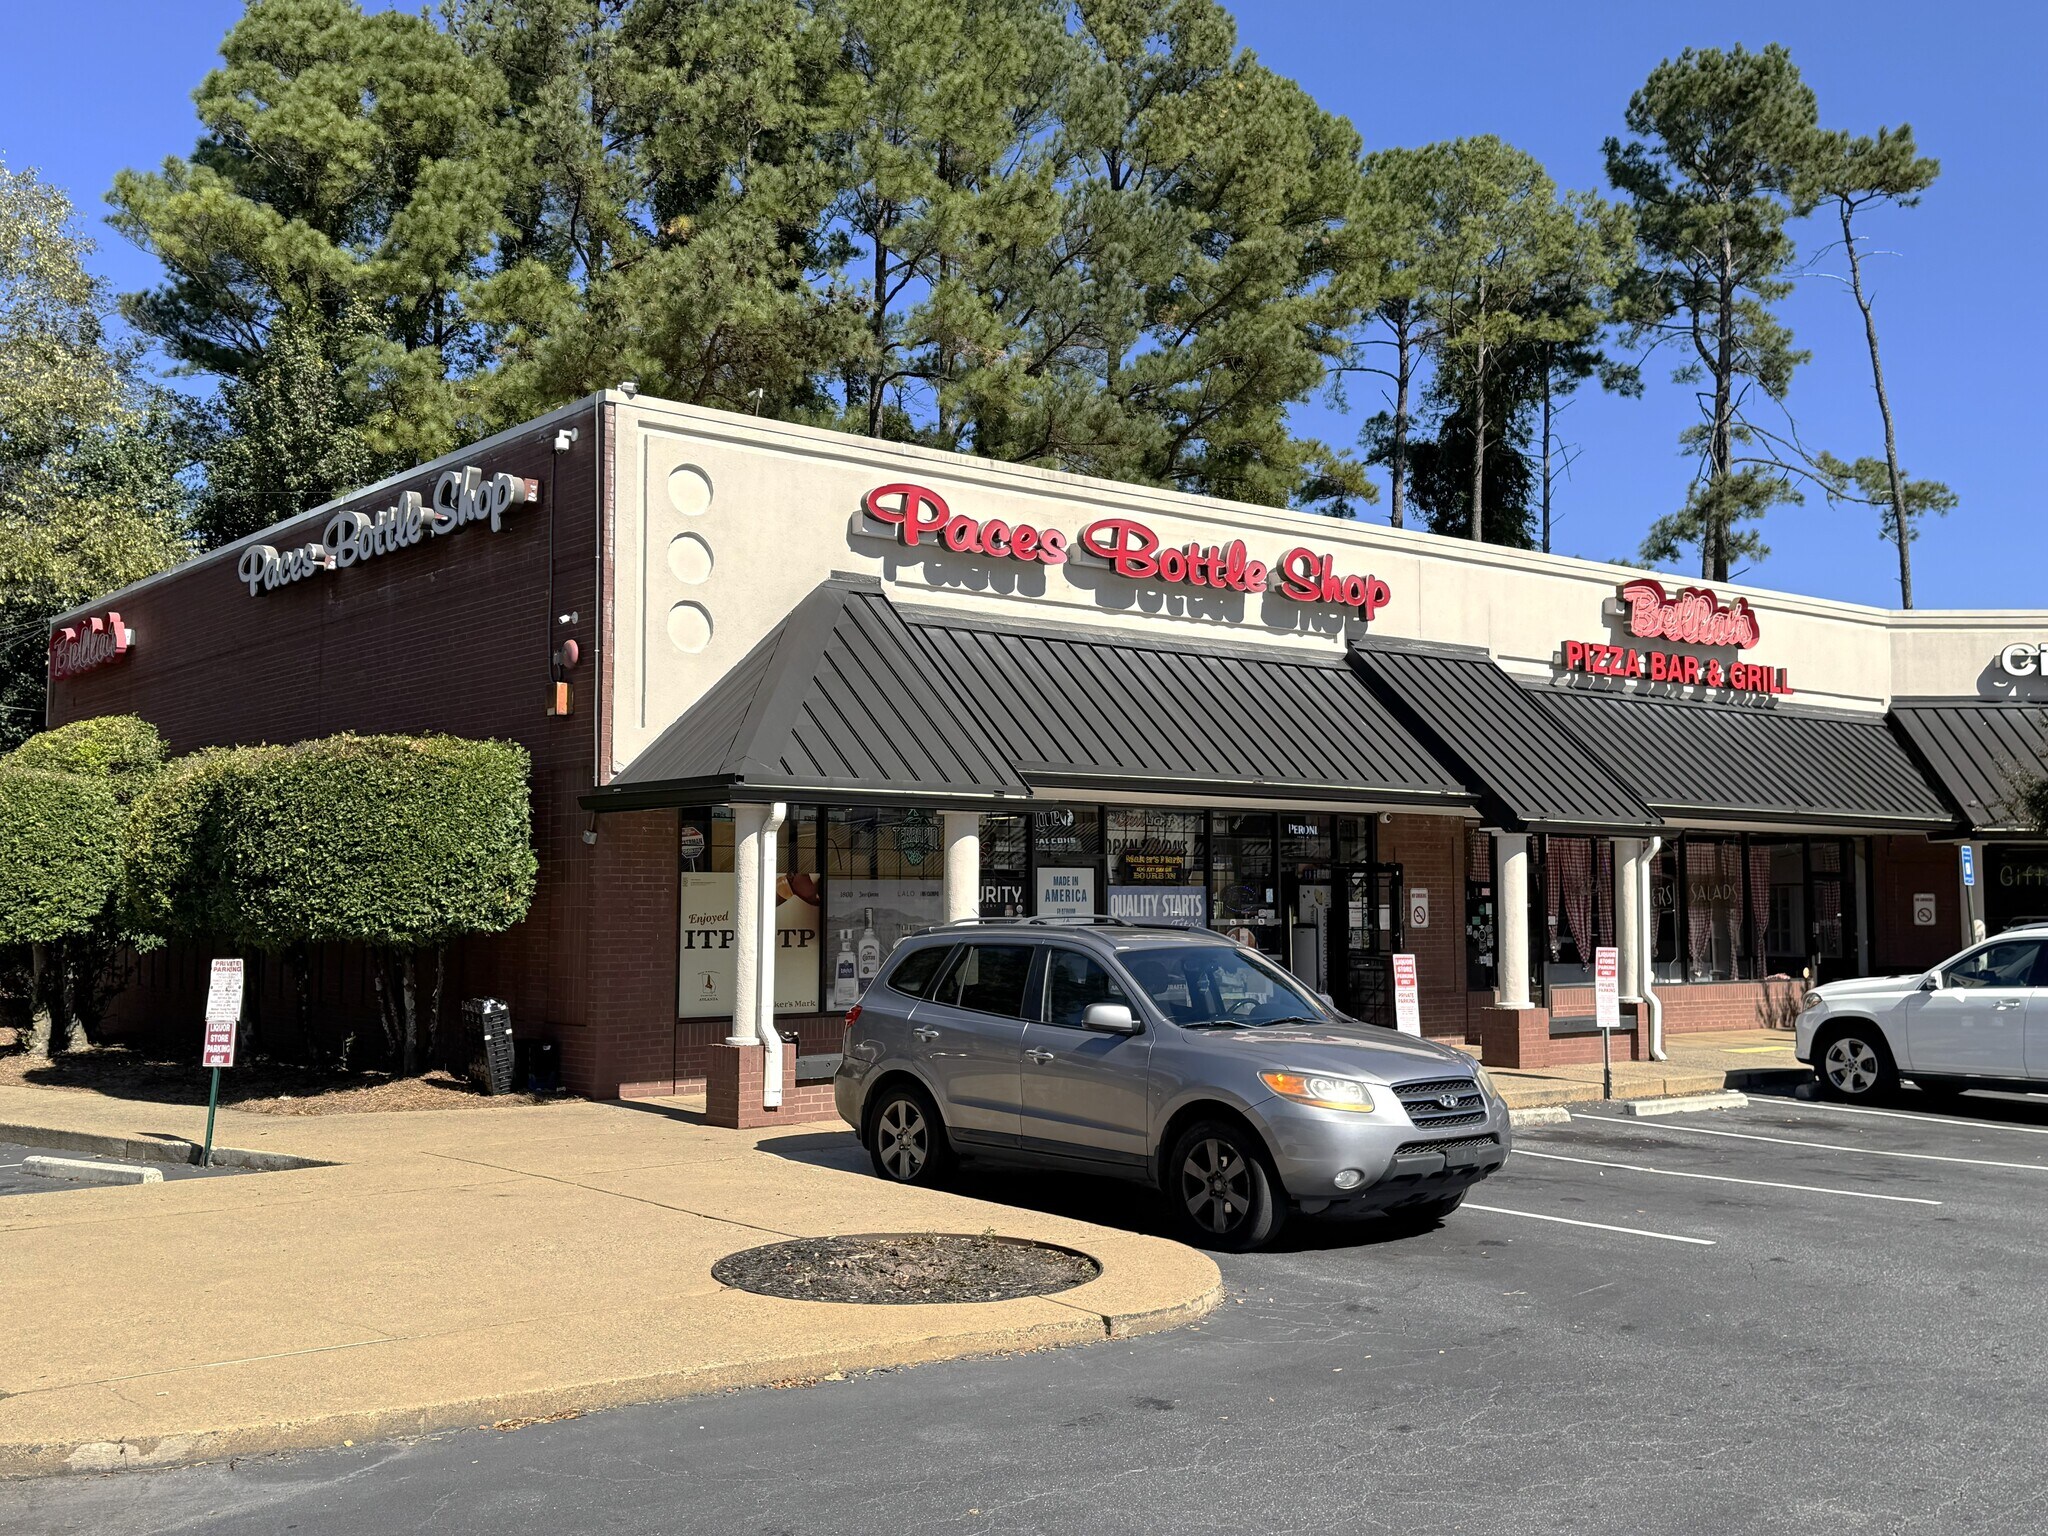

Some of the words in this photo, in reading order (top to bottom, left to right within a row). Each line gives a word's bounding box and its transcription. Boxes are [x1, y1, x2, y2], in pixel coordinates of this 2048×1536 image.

[238, 544, 320, 598] Paces
[322, 490, 430, 568] Bottle
[431, 465, 519, 533] Shop
[861, 483, 1067, 565] Paces
[1077, 518, 1267, 593] Bottle
[1276, 547, 1391, 622] Shop
[1564, 640, 1642, 678] PIZZA
[1649, 650, 1699, 684] BAR
[1706, 658, 1724, 687] &
[1729, 661, 1794, 695] GRILL
[1288, 823, 1319, 835] PERONI
[1053, 876, 1071, 886] MADE
[1072, 876, 1079, 886] IN
[2000, 865, 2048, 886] Gift
[1044, 889, 1088, 902] AMERICA
[1690, 882, 1739, 904] SALADS
[1110, 894, 1159, 918] QUALITY
[1162, 894, 1203, 917] STARTS
[688, 910, 729, 926] Enjoyed
[684, 929, 735, 950] ITP
[794, 1000, 816, 1008] Mark
[209, 1023, 231, 1032] LIQUOR
[210, 1034, 229, 1043] STORE
[206, 1044, 231, 1053] PARKING
